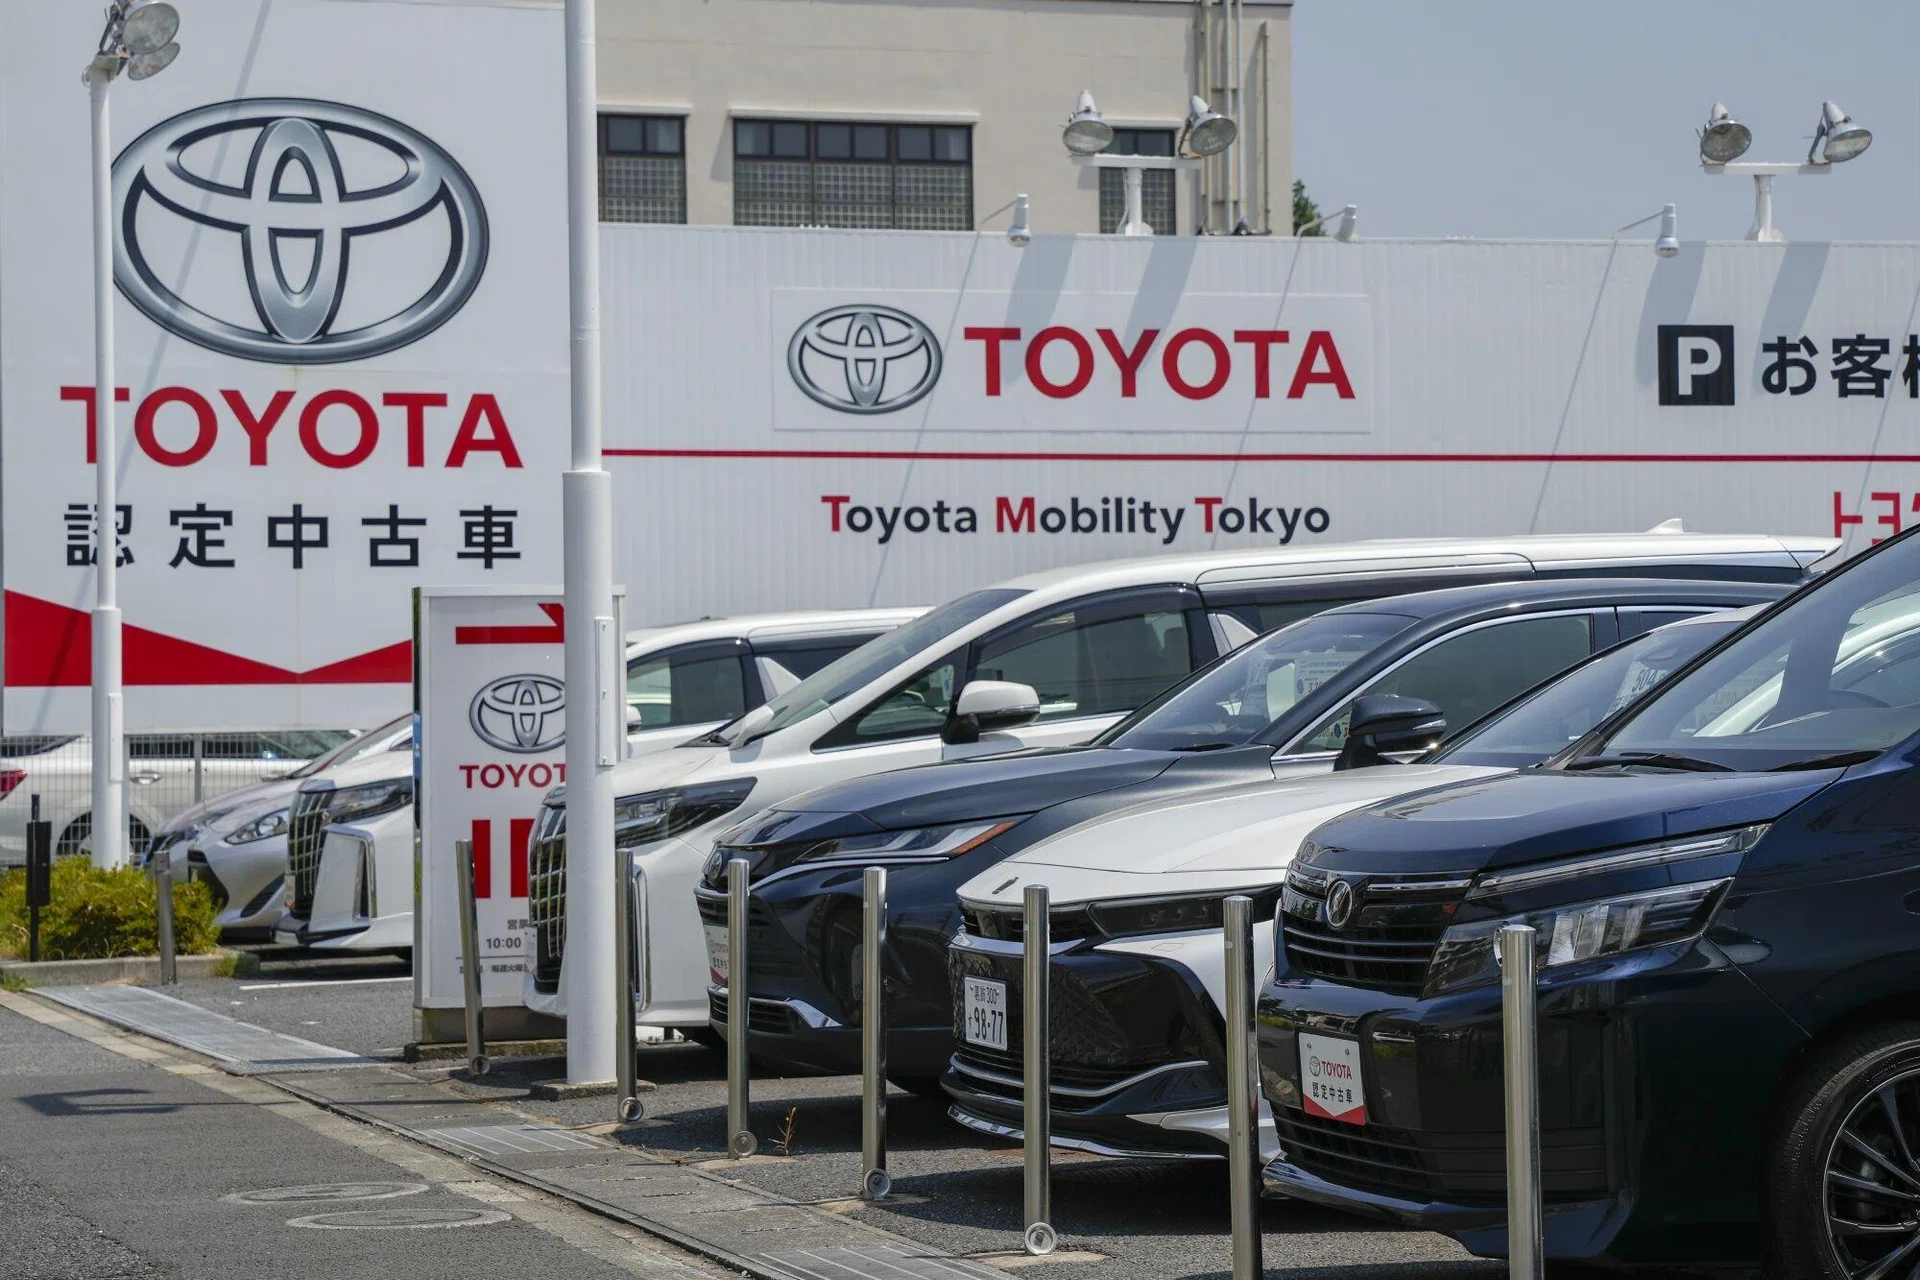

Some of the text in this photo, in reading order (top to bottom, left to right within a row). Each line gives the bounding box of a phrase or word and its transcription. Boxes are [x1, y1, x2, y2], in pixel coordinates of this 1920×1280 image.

[964, 325, 1355, 400] TOYOTA
[60, 386, 523, 469] TOYOTA
[64, 503, 521, 569] 認定中古車
[821, 496, 1330, 544] Toyota Mobility Tokyo
[1834, 492, 1920, 545] トヨ
[486, 937, 522, 949] 10:00
[1321, 1060, 1353, 1081] TOYOTA
